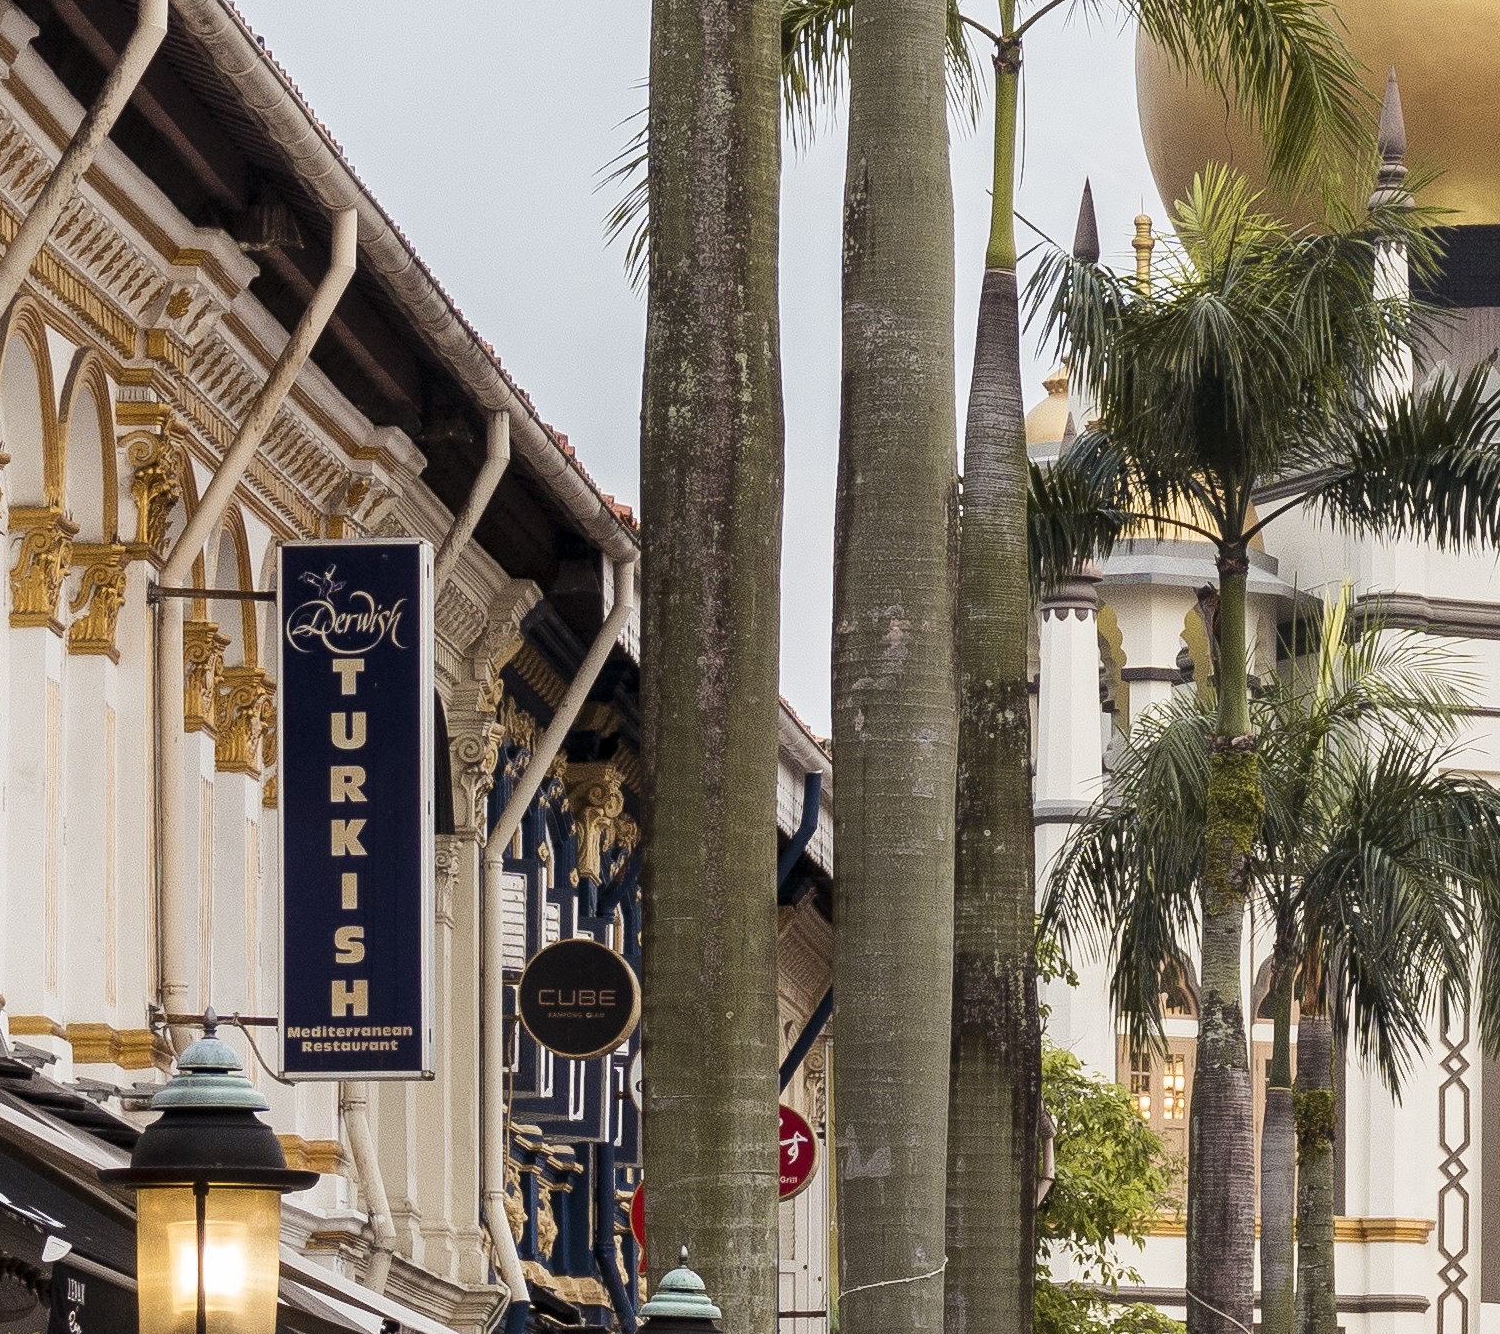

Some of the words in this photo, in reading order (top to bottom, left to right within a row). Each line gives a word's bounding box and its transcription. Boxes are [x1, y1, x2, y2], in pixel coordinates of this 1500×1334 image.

[286, 590, 409, 654] Derwish
[331, 658, 368, 1017] TURKISH
[538, 989, 616, 1006] CUBE
[286, 1025, 413, 1039] Mediterranean
[301, 1039, 399, 1053] Restaurant
